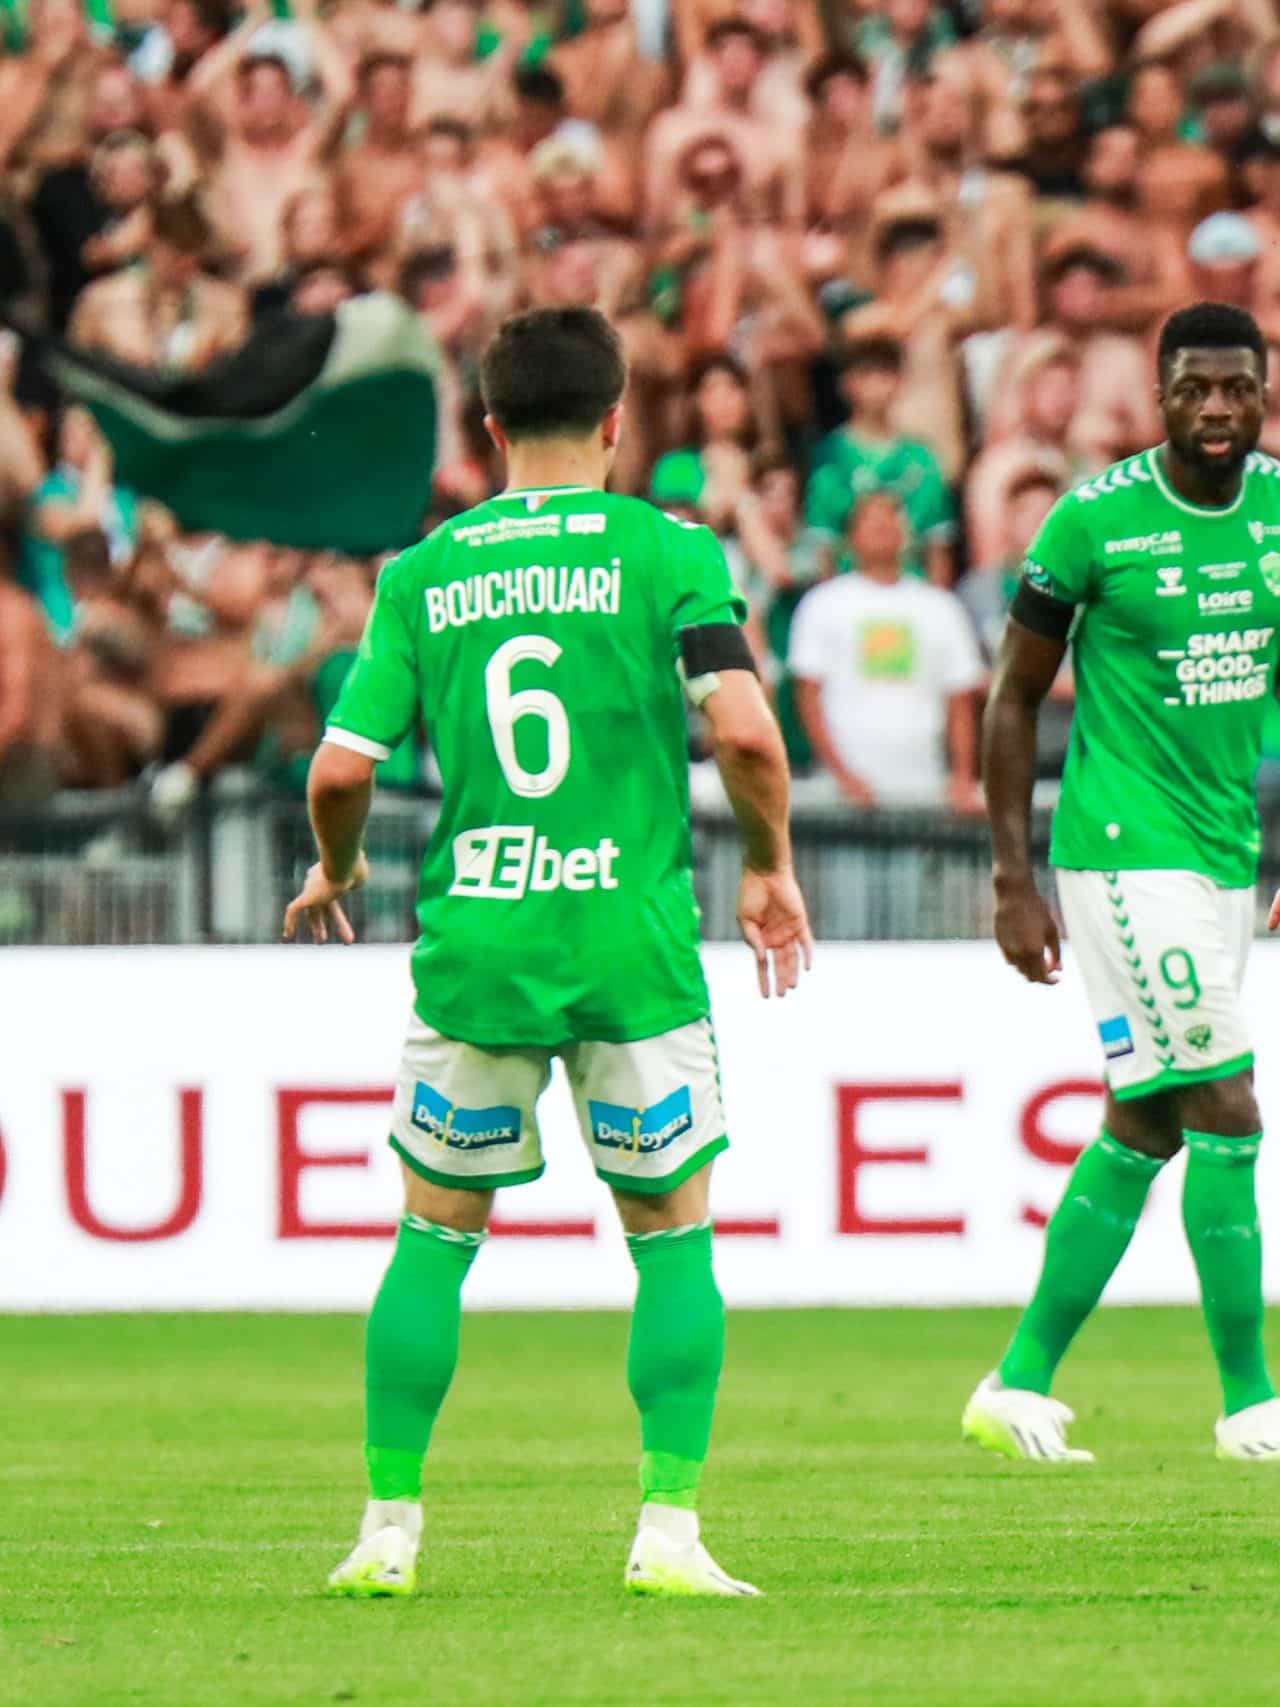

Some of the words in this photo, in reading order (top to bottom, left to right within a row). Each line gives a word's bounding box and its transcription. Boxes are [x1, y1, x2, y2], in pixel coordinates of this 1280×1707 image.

[1187, 627, 1274, 658] SMART
[1176, 653, 1254, 683] GOOD
[1181, 674, 1267, 706] THINGS
[485, 635, 570, 798] 6
[1159, 947, 1202, 1011] 9
